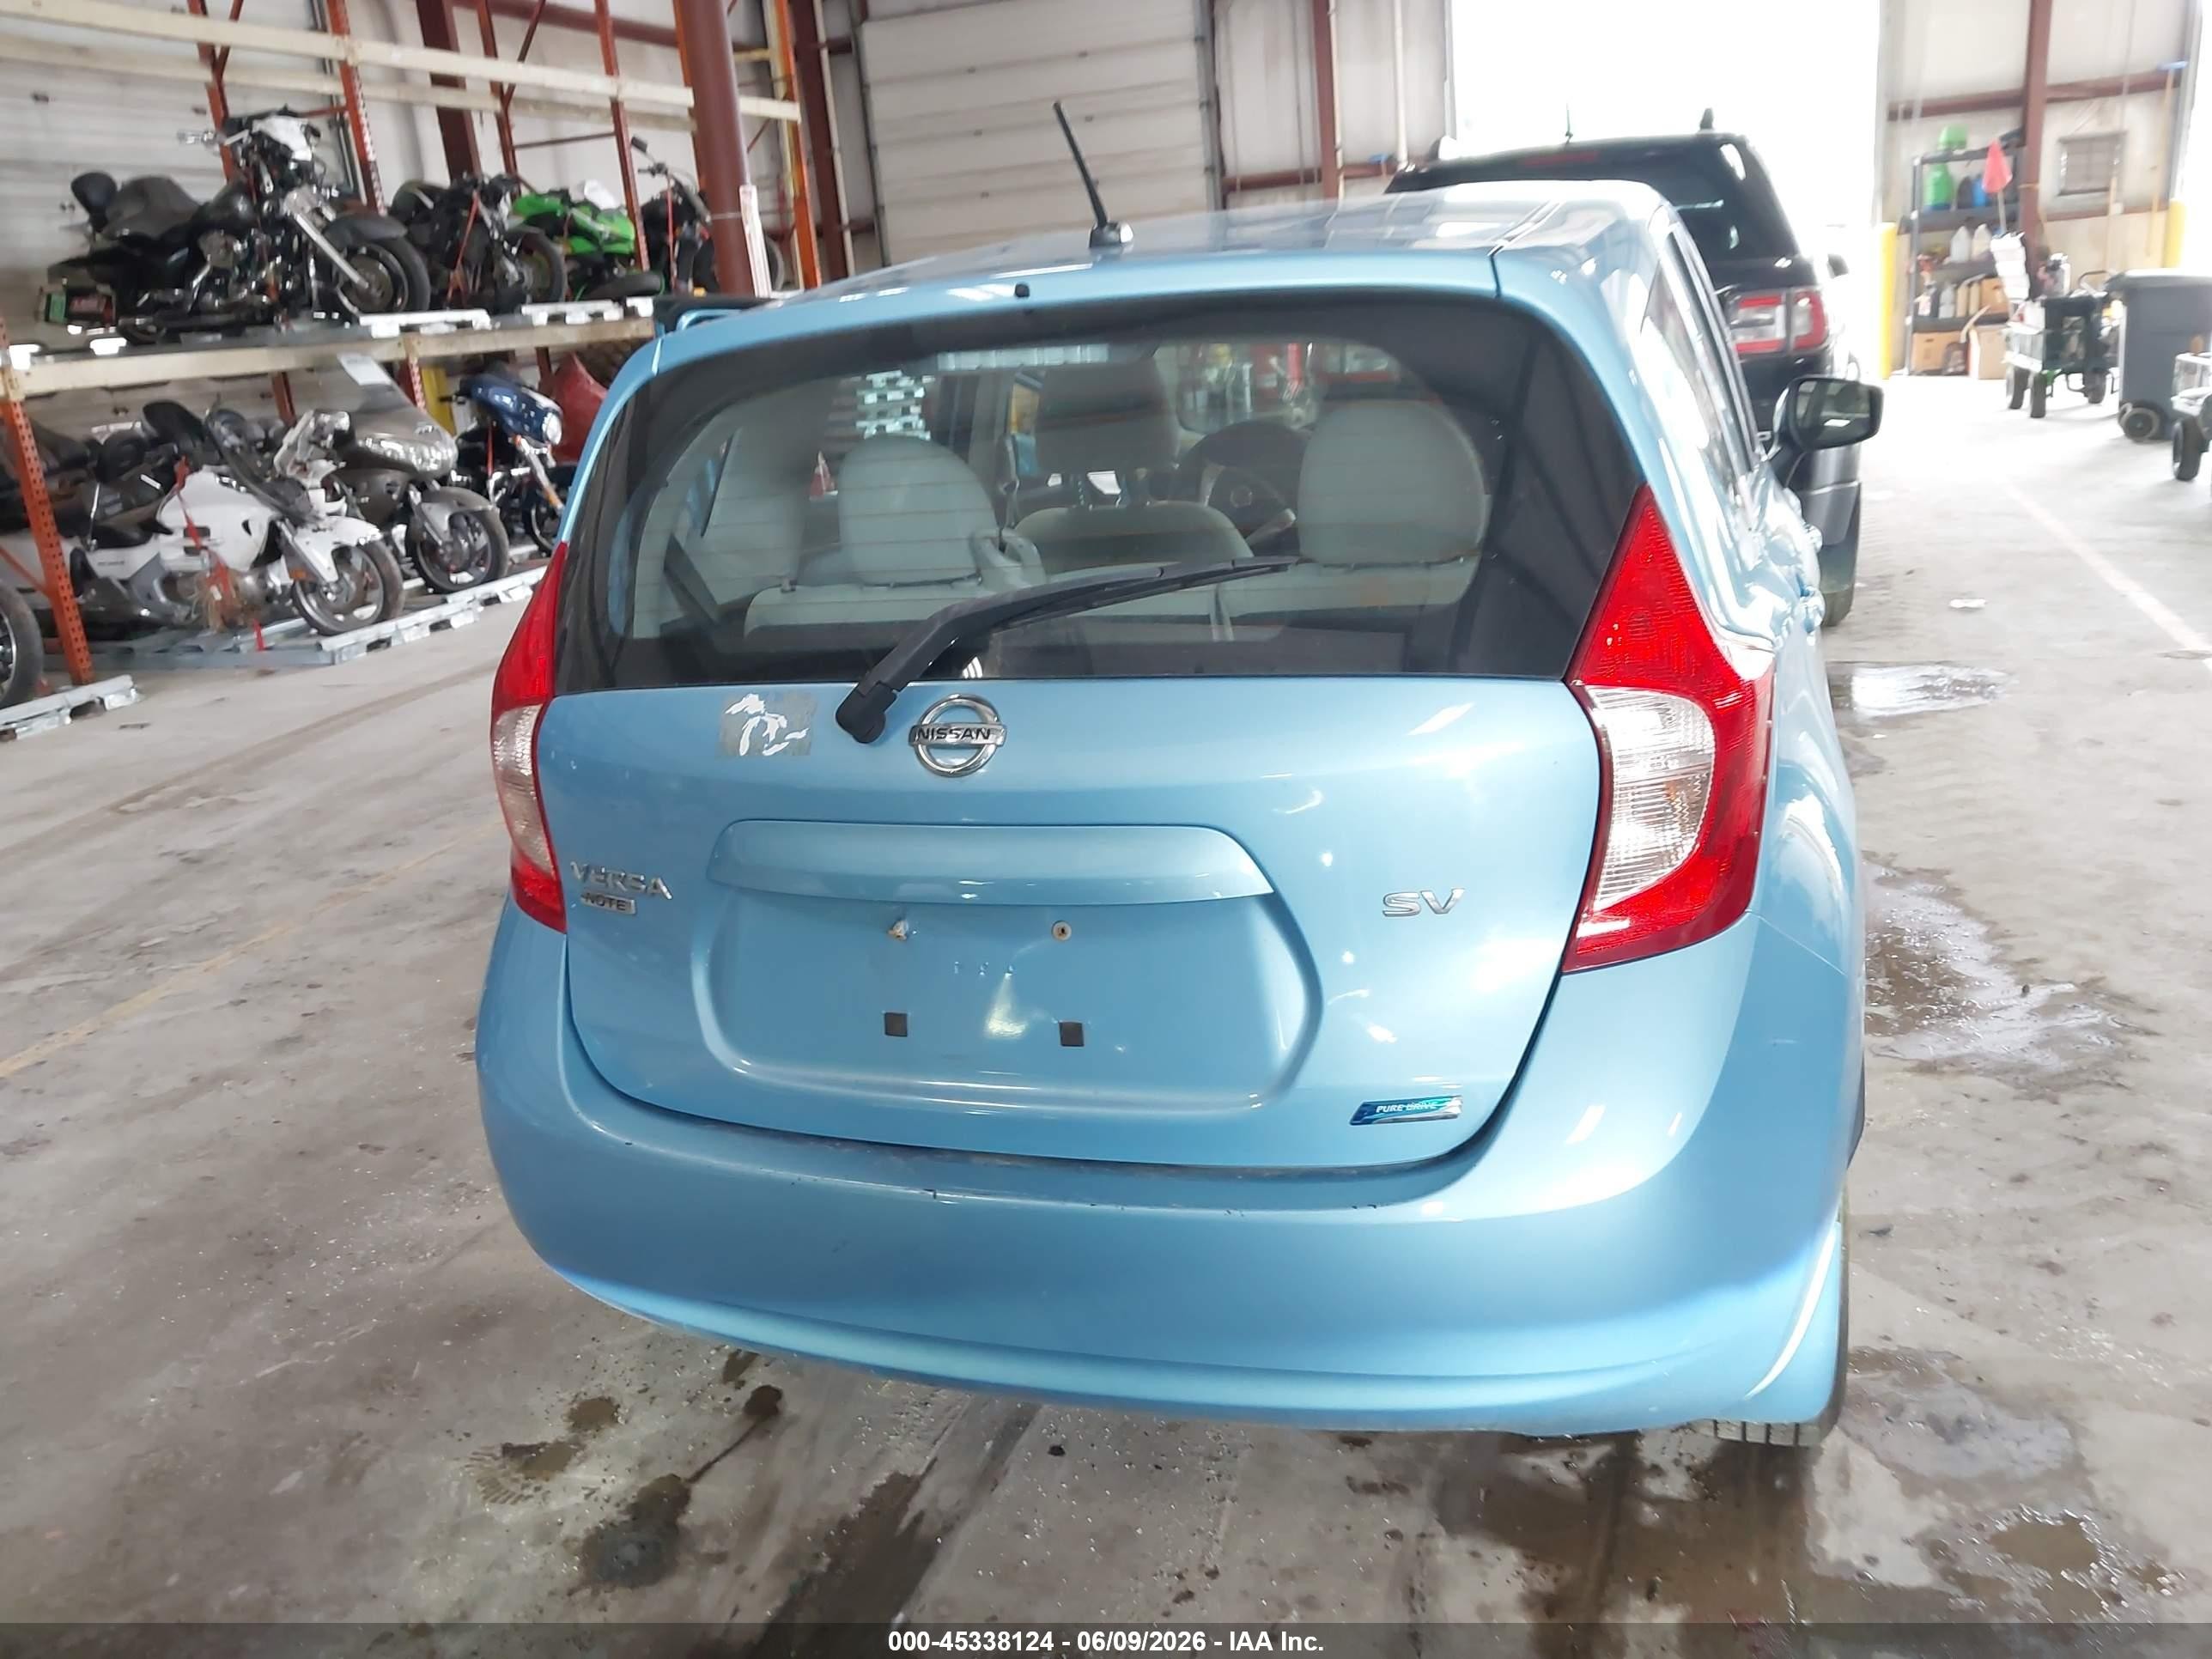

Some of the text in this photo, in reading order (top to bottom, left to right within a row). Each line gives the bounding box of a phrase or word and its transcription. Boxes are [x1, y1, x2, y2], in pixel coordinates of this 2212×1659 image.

[915, 726, 992, 741] NISSAN
[569, 860, 673, 901] VERSA
[583, 891, 628, 912] NOTE
[1382, 887, 1465, 918] SV
[1376, 1099, 1440, 1114] PURE DRIVE
